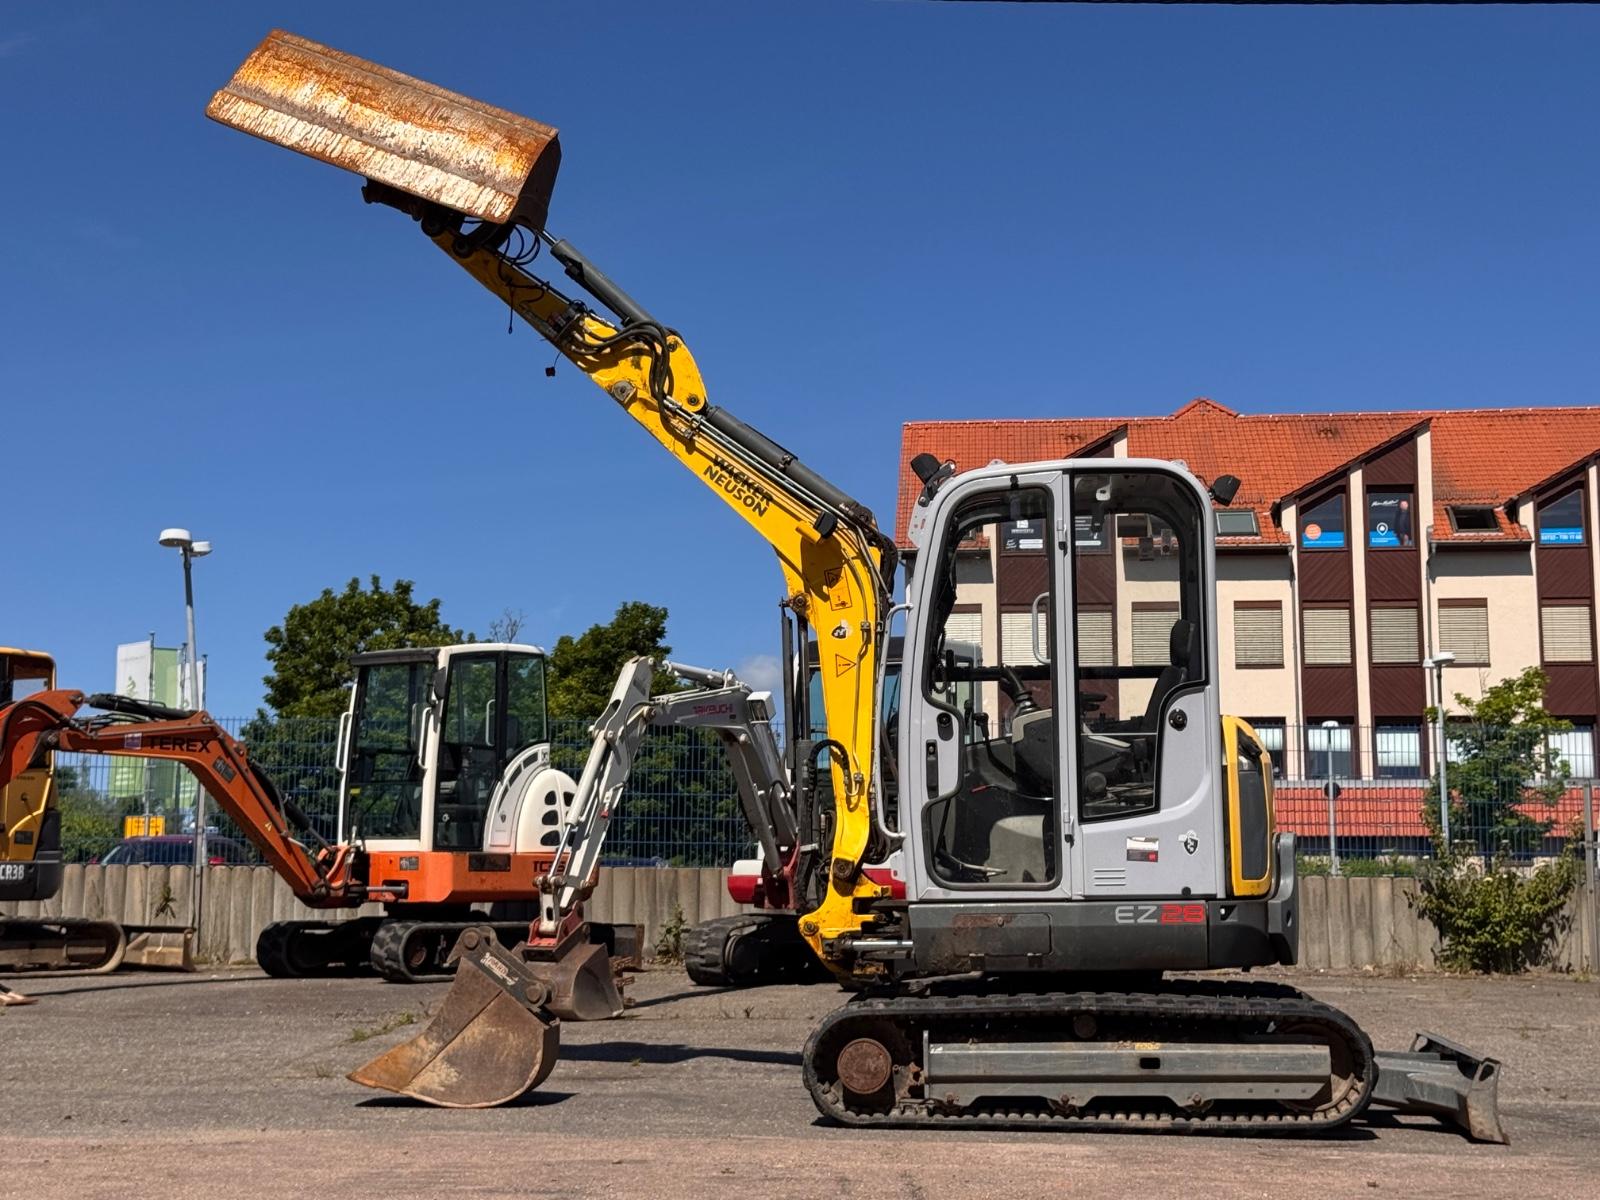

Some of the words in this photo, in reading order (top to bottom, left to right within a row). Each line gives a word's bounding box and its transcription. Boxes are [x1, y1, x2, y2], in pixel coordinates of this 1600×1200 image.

[703, 464, 769, 518] NEUSON
[712, 453, 772, 508] WACKER
[149, 735, 211, 754] TEREX
[1115, 903, 1205, 924] EZ28
